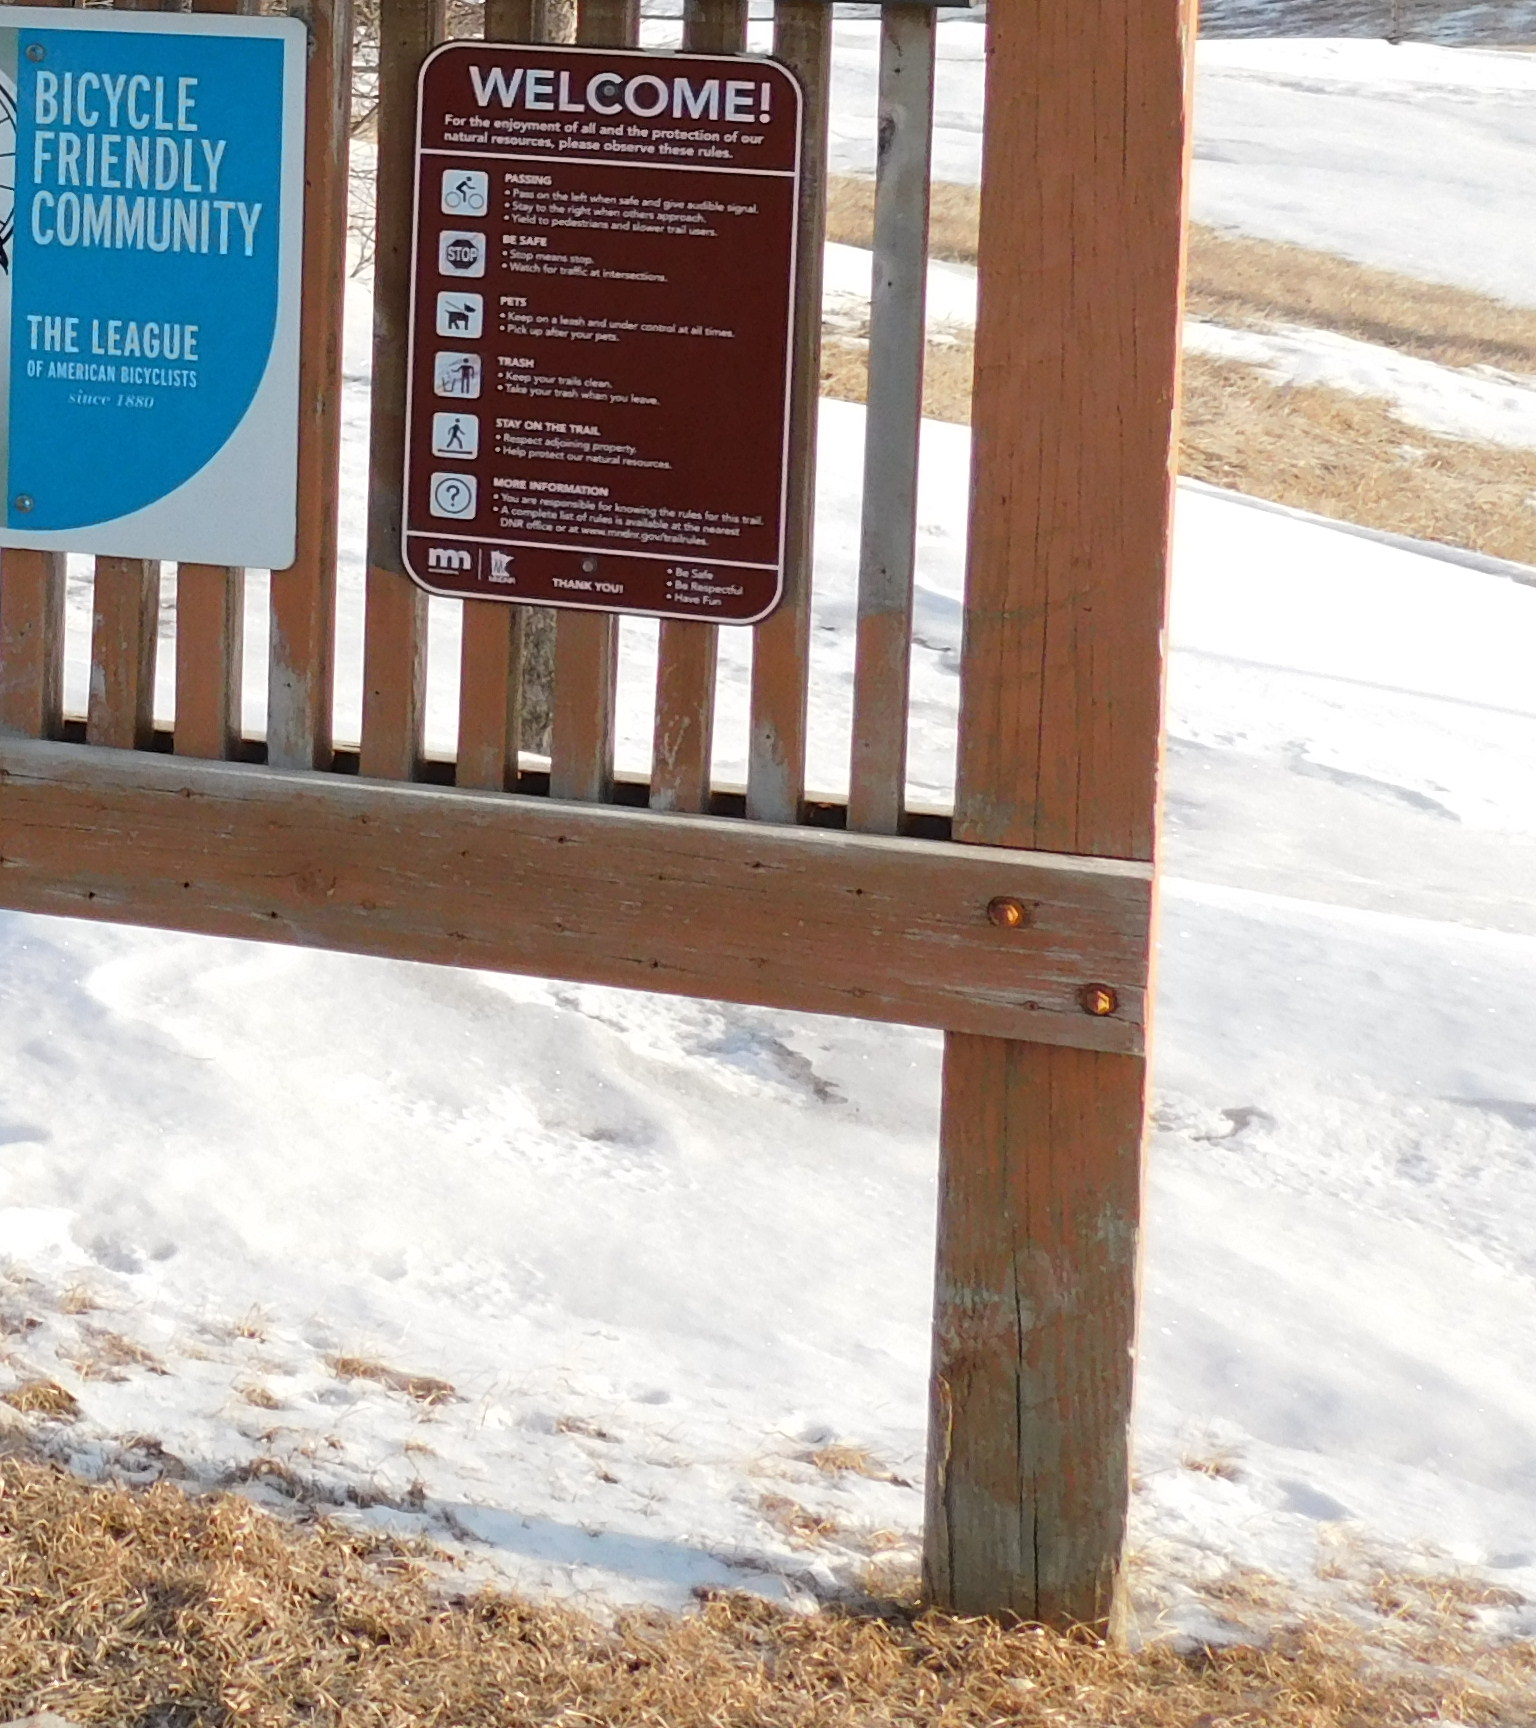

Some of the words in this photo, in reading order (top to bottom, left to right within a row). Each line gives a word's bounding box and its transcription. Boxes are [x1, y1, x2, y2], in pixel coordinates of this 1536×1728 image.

[35, 70, 197, 130] BICYCLE
[469, 66, 770, 123] WELCOME!
[445, 114, 466, 125] For
[469, 115, 490, 131] the
[493, 118, 561, 133] enjoyment
[564, 121, 578, 132] of
[580, 122, 596, 133] all
[599, 124, 623, 135] and
[627, 125, 648, 137] the
[651, 129, 719, 141] protection
[723, 131, 738, 142] of
[741, 135, 764, 144] our
[444, 131, 488, 143] natural
[491, 136, 554, 148] resources,
[559, 137, 600, 150] please
[603, 139, 655, 153] observe
[658, 143, 694, 156] these
[698, 145, 733, 158] rules.
[34, 130, 225, 192] FRIENDLY
[505, 173, 551, 185] PASSING
[32, 190, 261, 256] COMMUNITY
[502, 235, 516, 244] BE
[519, 236, 547, 246] SAFE
[447, 246, 478, 262] STOP
[500, 296, 526, 306] PETS
[27, 315, 79, 352] THE
[92, 319, 198, 360] LEAGUE
[497, 356, 534, 367] TRASH
[27, 360, 43, 377] OF
[48, 361, 115, 381] AMERICAN
[121, 366, 196, 387] BICYCLISTS
[496, 418, 522, 428] STAY
[524, 420, 542, 430] ON
[544, 422, 566, 432] THE
[569, 424, 600, 435] TRAIL
[493, 477, 526, 489] MORE
[529, 481, 608, 496] INFORMATION
[552, 578, 592, 590] THANK
[594, 582, 623, 593] YOU!
